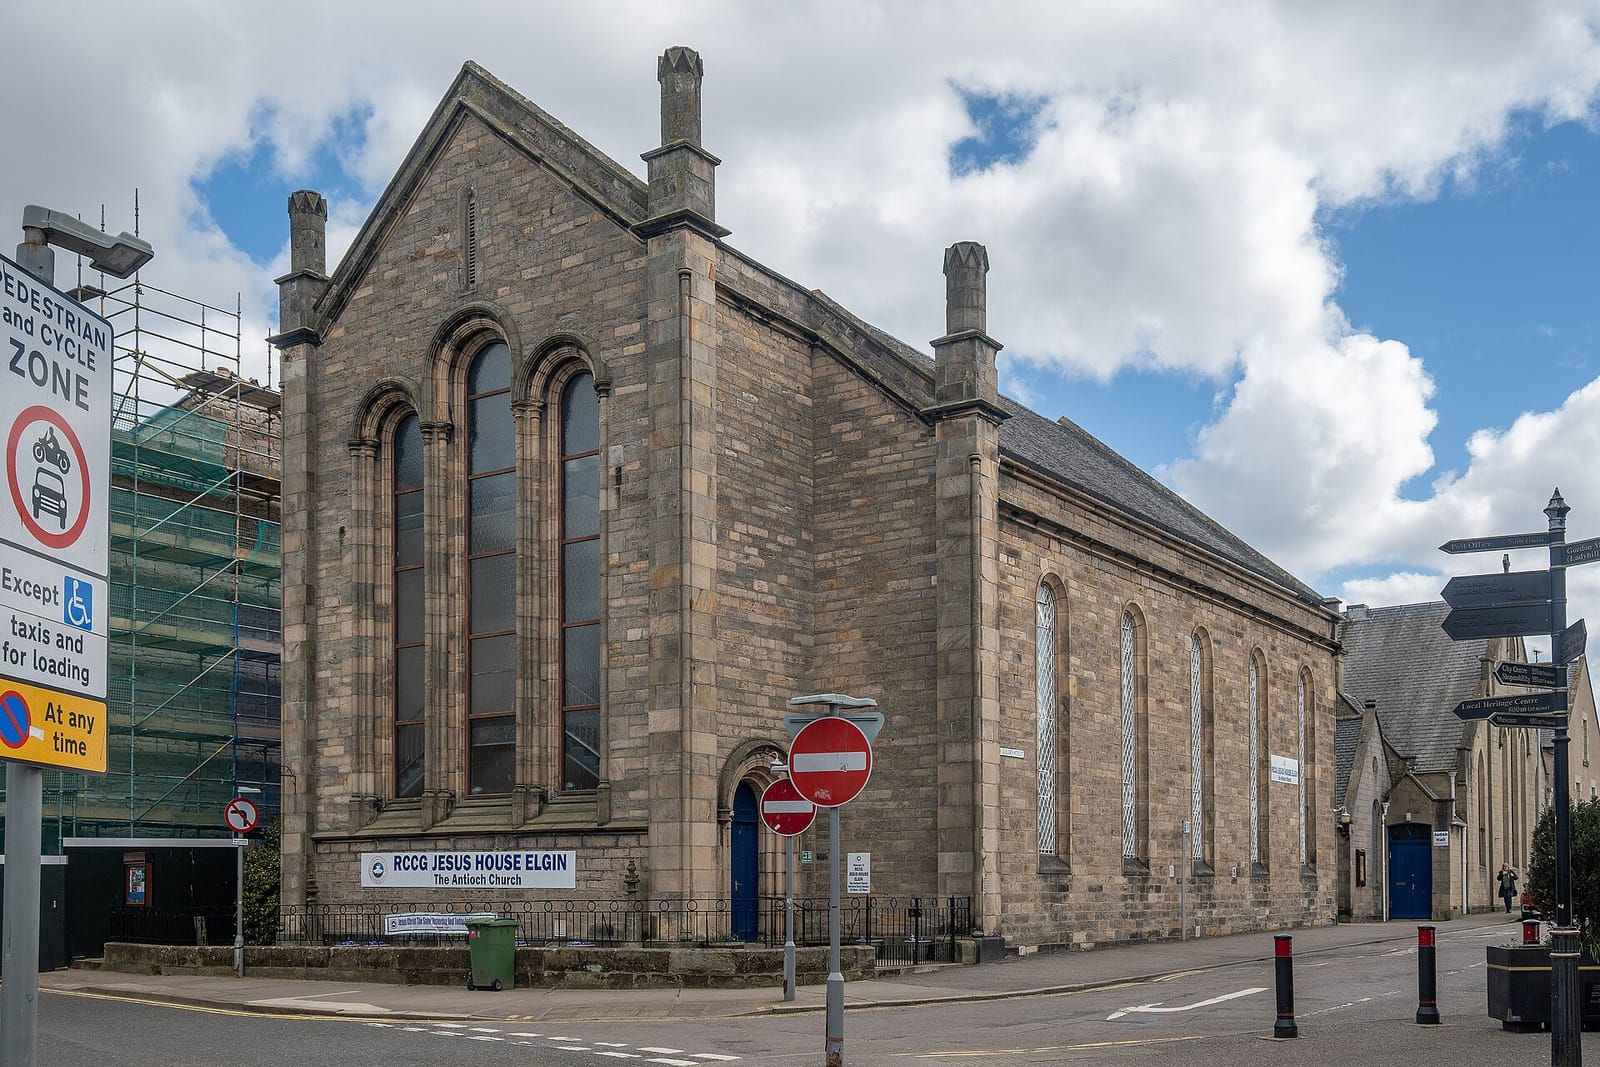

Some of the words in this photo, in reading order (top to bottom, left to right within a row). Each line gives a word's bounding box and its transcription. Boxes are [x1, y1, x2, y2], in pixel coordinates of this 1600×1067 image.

[0, 269, 106, 351] EDESTRIAN
[3, 306, 34, 336] and
[41, 322, 96, 372] CYCLE
[9, 337, 90, 412] ZONE
[2, 567, 59, 606] Except
[11, 614, 50, 645] taxis
[56, 632, 84, 655] and
[2, 641, 27, 667] for
[33, 649, 90, 687] loading
[45, 702, 63, 725] At
[68, 711, 95, 734] any
[1483, 699, 1513, 708] Heritage
[53, 731, 87, 756] time
[393, 855, 428, 871] RCCG
[432, 855, 471, 871] JESUS
[475, 854, 521, 871] HOUSE
[525, 854, 567, 871] ELGIN
[434, 873, 449, 885] The
[452, 873, 486, 886] Antioch
[488, 873, 521, 886] Church
